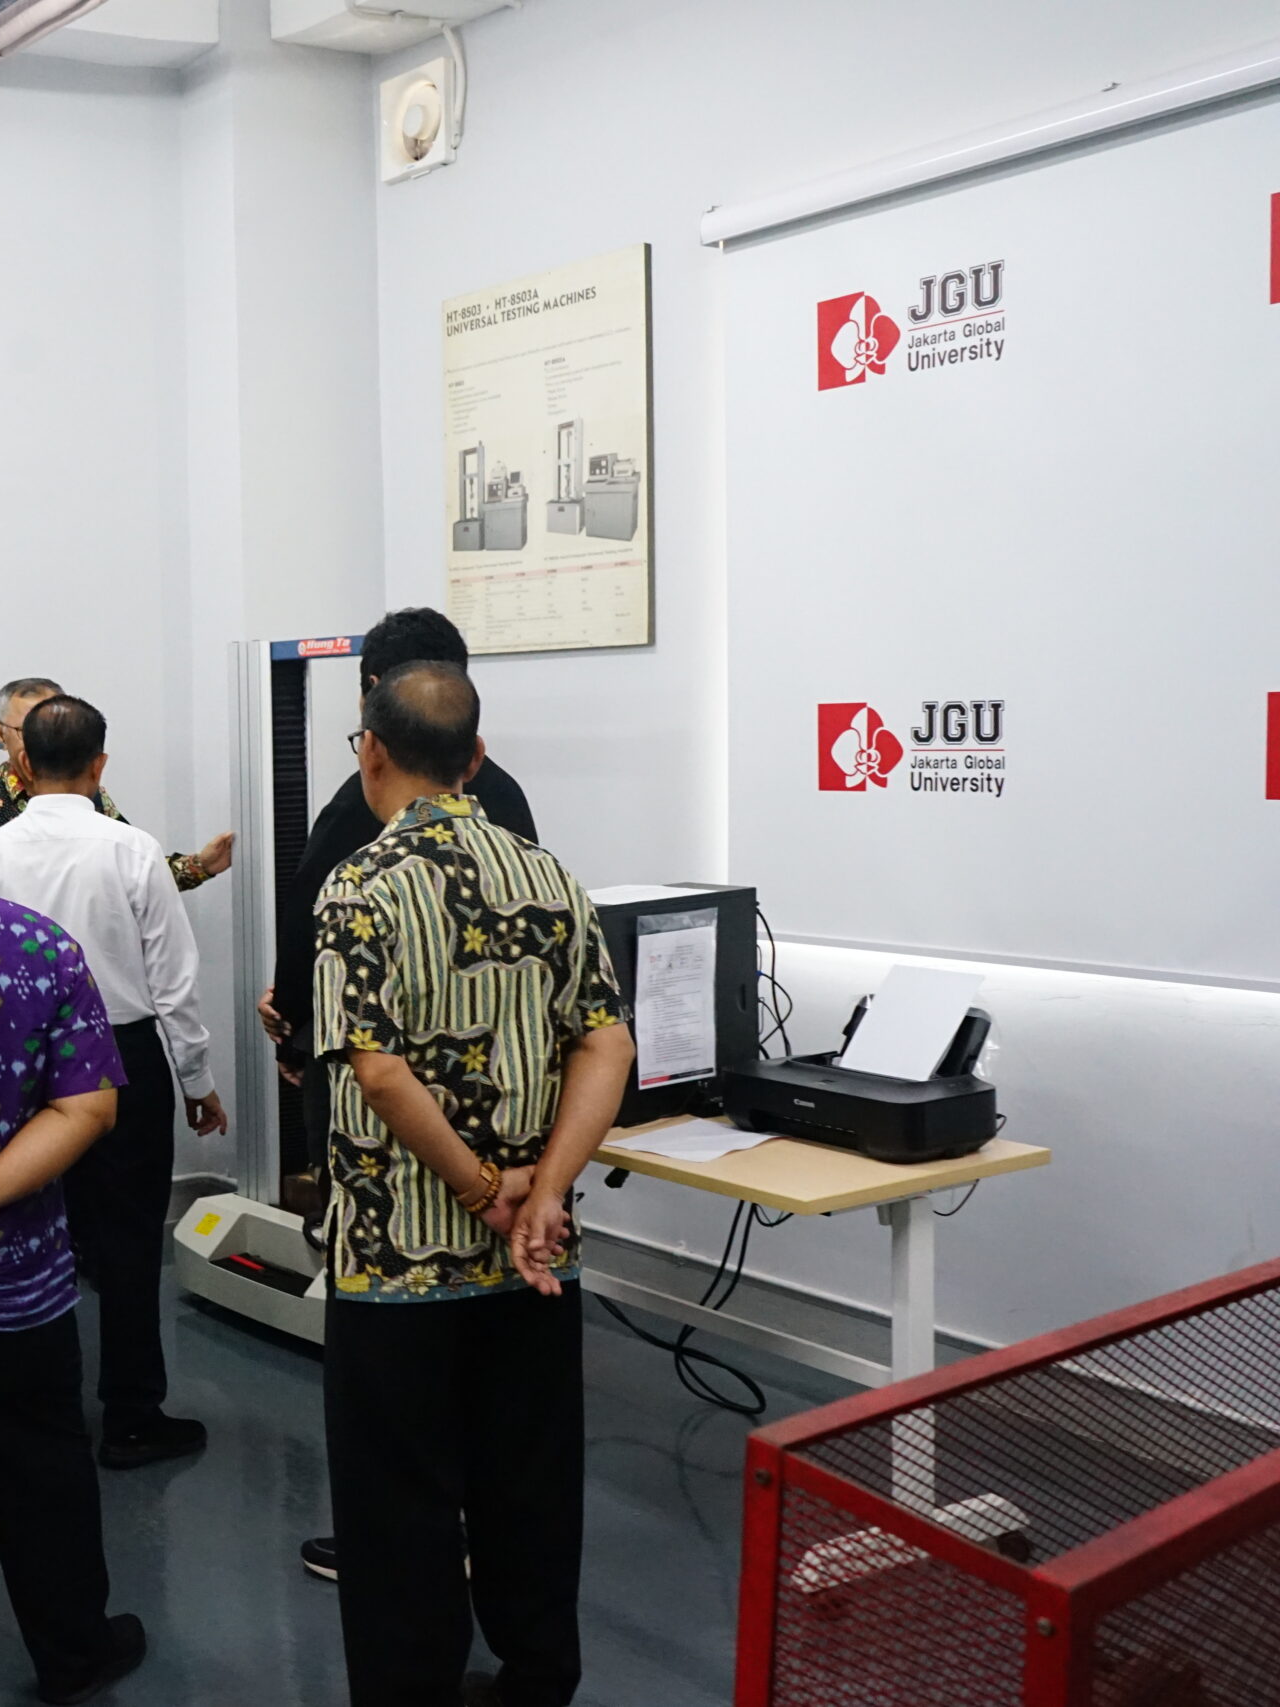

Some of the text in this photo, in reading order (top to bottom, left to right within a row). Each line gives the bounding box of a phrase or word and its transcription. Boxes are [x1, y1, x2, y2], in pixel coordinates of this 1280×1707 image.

[446, 288, 540, 324] HT-8503 HT-8503A
[908, 259, 1005, 325] JGU
[446, 286, 597, 337] UNIVERSAL TESTING MACHINES
[908, 316, 1005, 350] Jakarta Global
[908, 337, 1005, 372] University
[910, 700, 1005, 746] JGU
[910, 754, 1005, 769] Jakarta Global
[910, 771, 1005, 798] University
